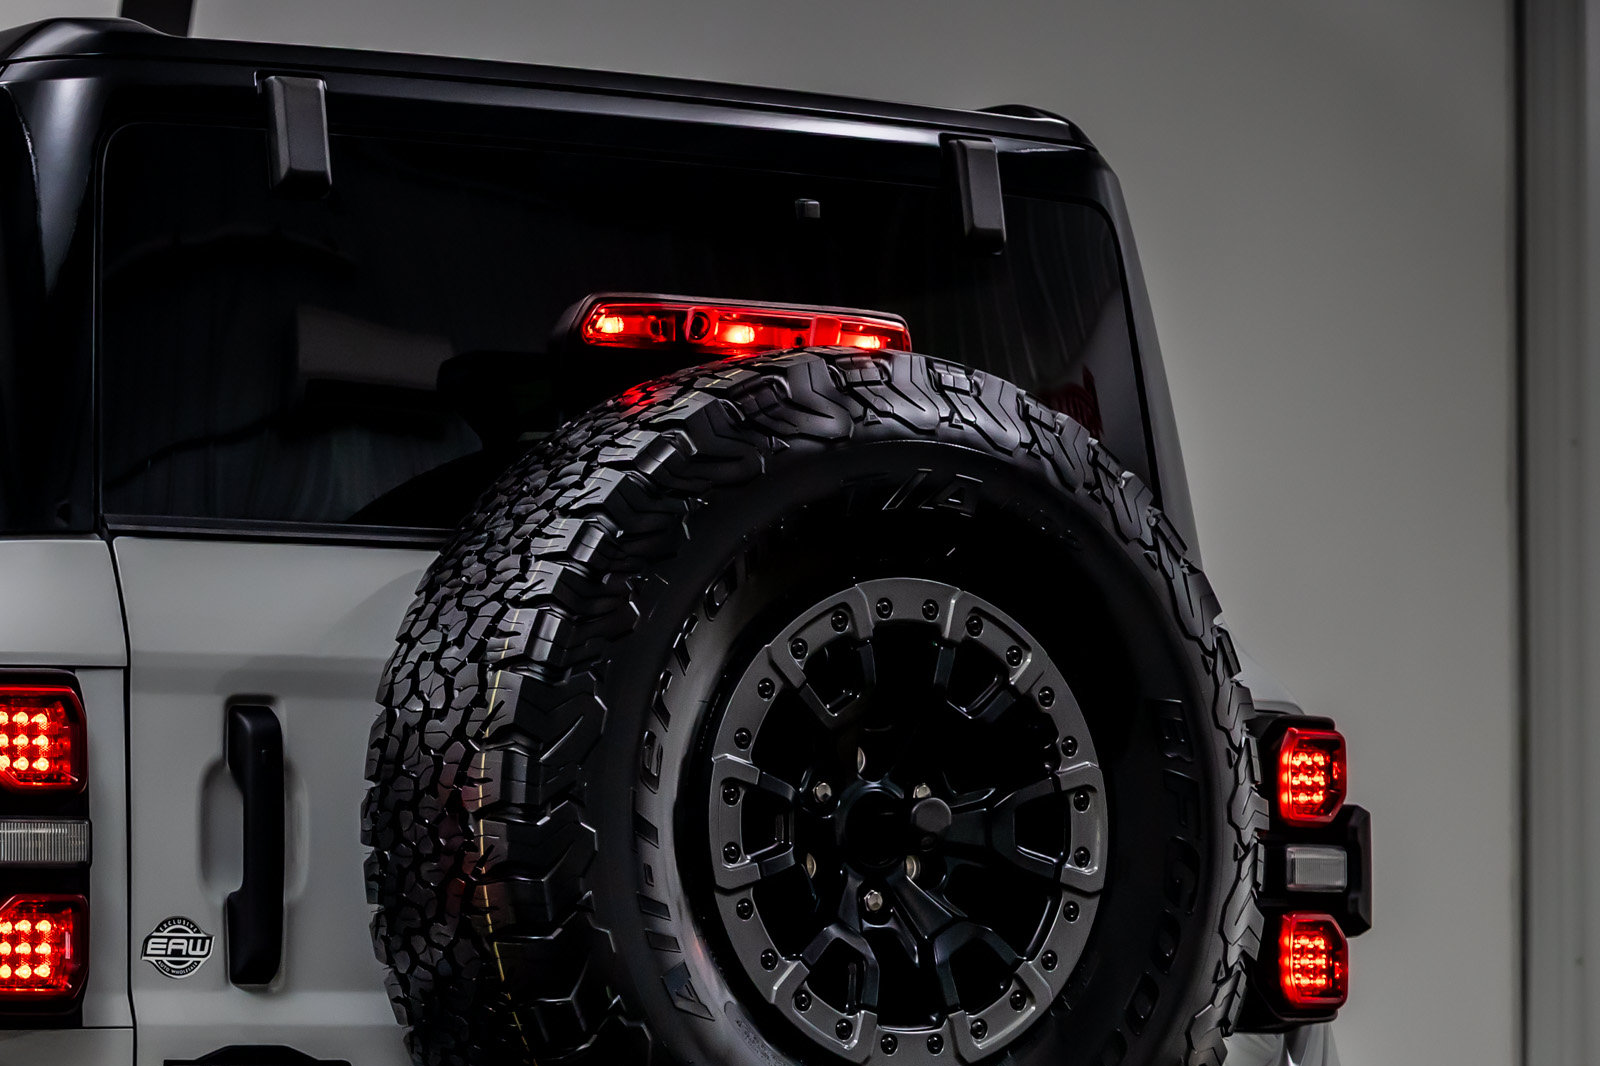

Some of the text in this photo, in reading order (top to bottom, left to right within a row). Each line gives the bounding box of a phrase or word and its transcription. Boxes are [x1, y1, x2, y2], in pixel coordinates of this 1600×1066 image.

[159, 919, 198, 932] EXCLUSIVE
[146, 938, 210, 955] EAW
[157, 960, 198, 975] AUTO WHOLESALE
